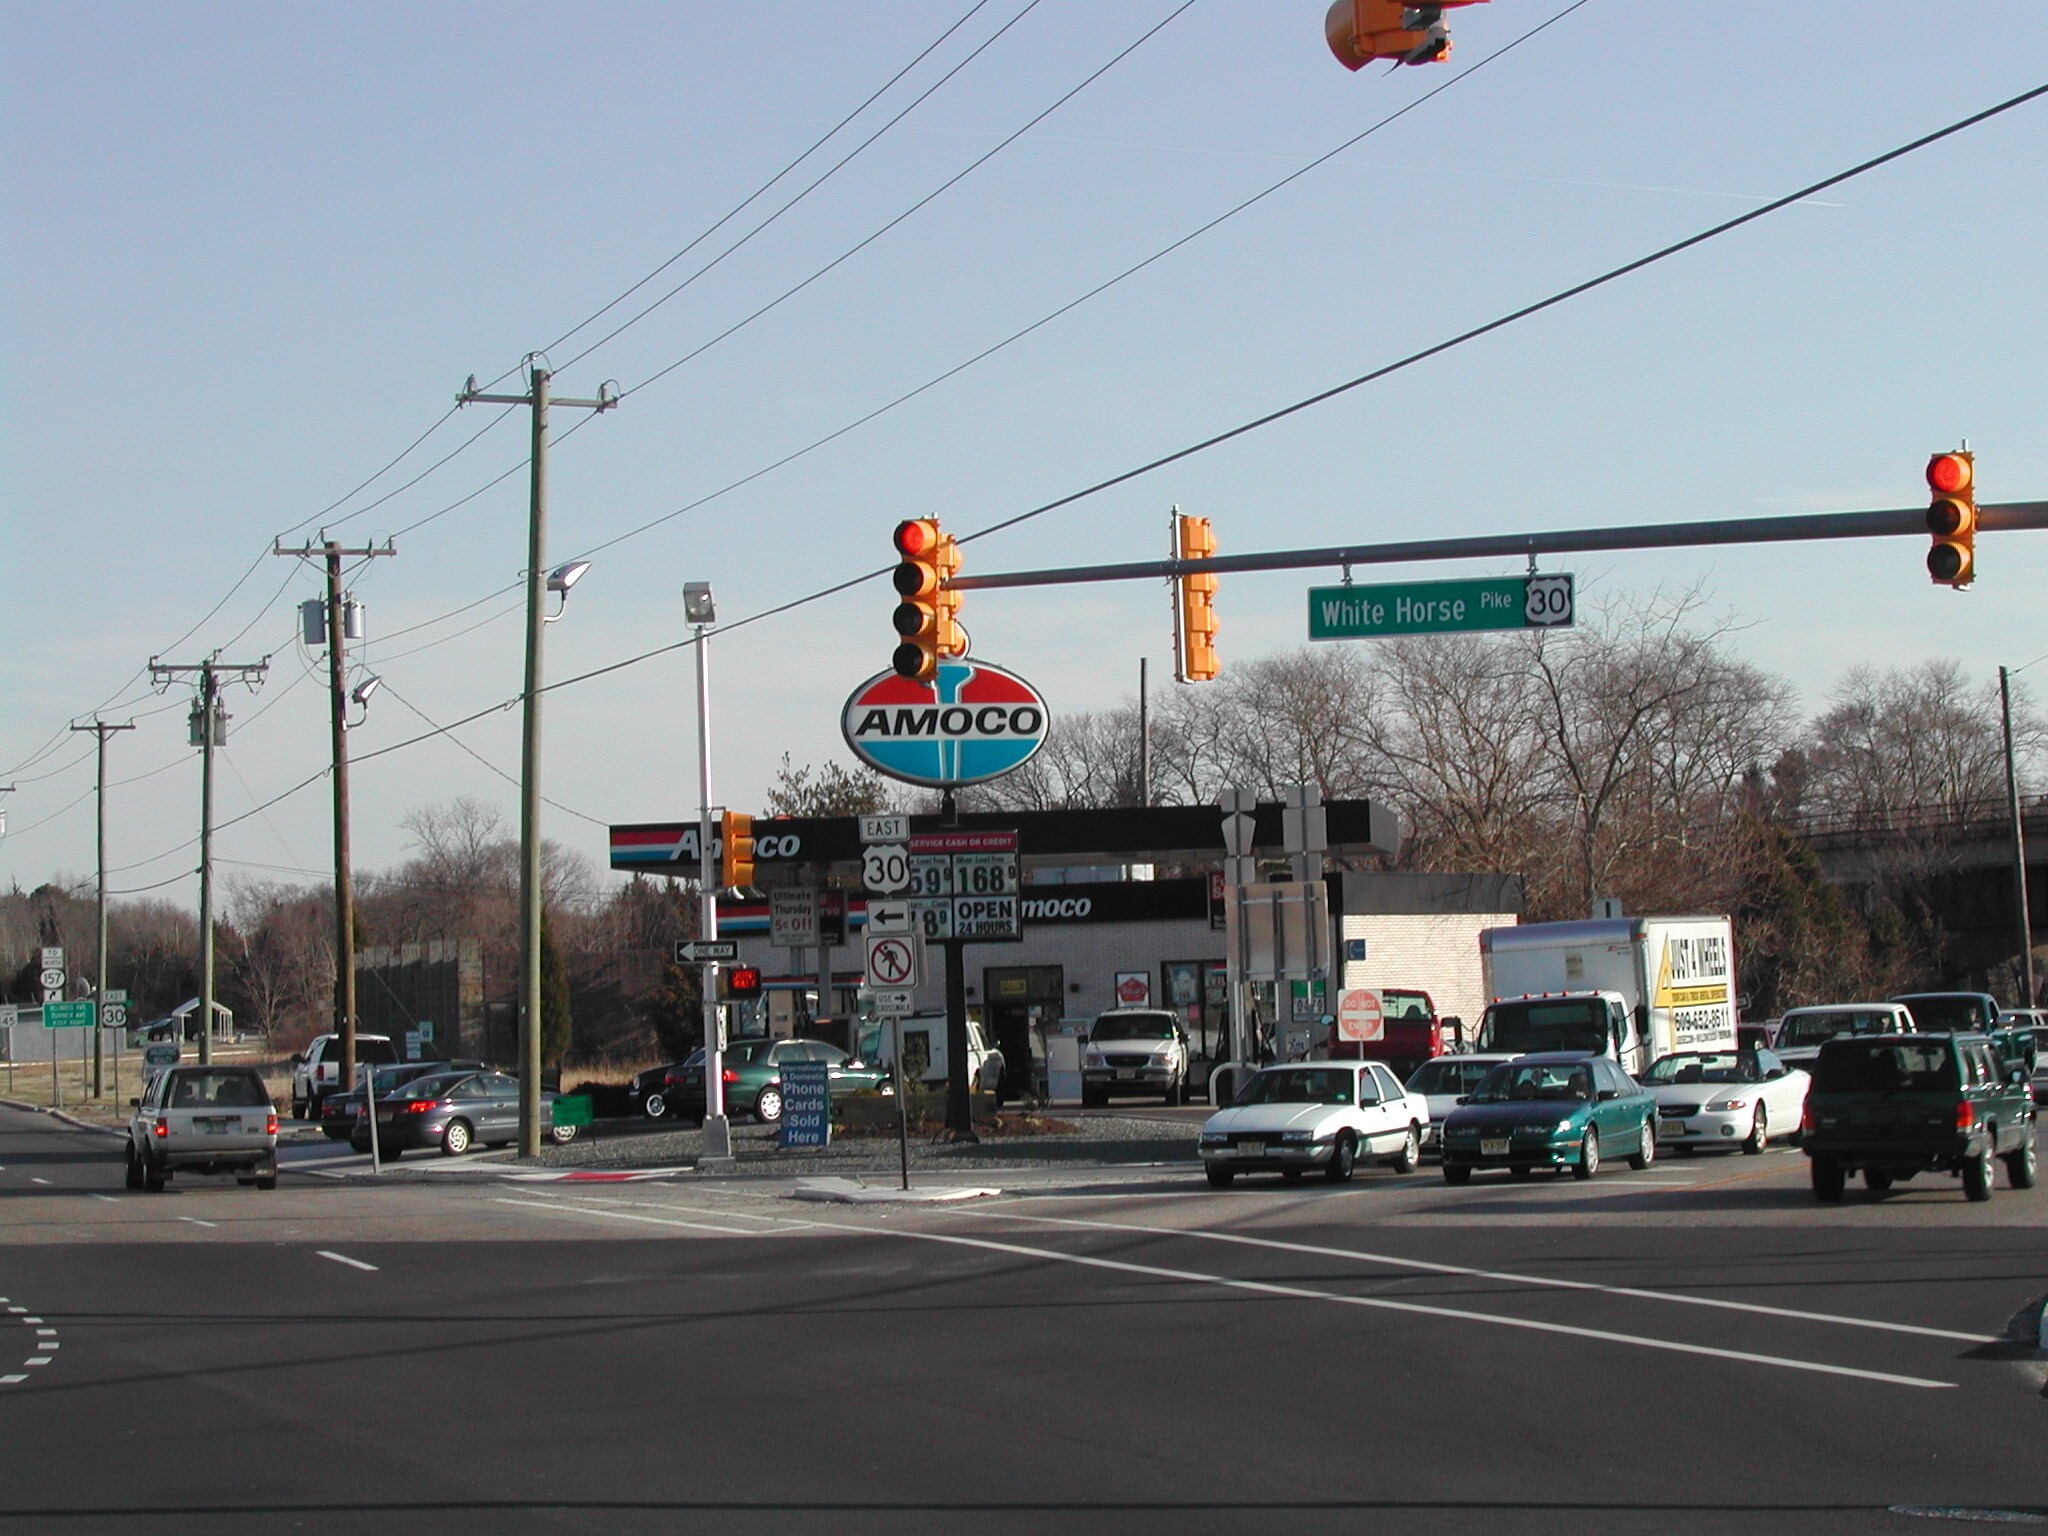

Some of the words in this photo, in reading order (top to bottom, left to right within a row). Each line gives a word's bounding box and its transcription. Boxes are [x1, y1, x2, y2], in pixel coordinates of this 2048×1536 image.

[1530, 587, 1566, 614] 30
[1322, 600, 1385, 627] White
[1396, 597, 1466, 624] Horse
[1480, 591, 1512, 609] Pike
[854, 706, 1042, 736] AMOCO
[867, 820, 900, 836] EAST
[910, 839, 943, 848] SERVICE
[945, 838, 967, 847] CASH
[983, 837, 1012, 846] CREDIT
[868, 855, 905, 884] 30
[774, 890, 812, 901] Ultimate
[775, 904, 812, 916] Thursday
[958, 902, 1012, 919] OPEN
[1021, 897, 1092, 918] moco
[791, 917, 812, 931] Off
[959, 922, 972, 936] 24
[975, 920, 1012, 935] HOURS
[47, 949, 58, 957] TO
[693, 946, 709, 956] ONE
[713, 945, 731, 955] WAY
[1670, 938, 1690, 979] JUST
[1696, 936, 1727, 977] WHEELS
[44, 973, 61, 985] 157
[878, 994, 892, 1002] USE
[1345, 999, 1357, 1008] DO
[2, 1016, 16, 1026] 45
[106, 1010, 124, 1024] 30
[783, 1082, 825, 1095] Phone
[784, 1098, 825, 1111] Cards
[790, 1114, 820, 1127] Sold
[788, 1130, 819, 1143] Here
